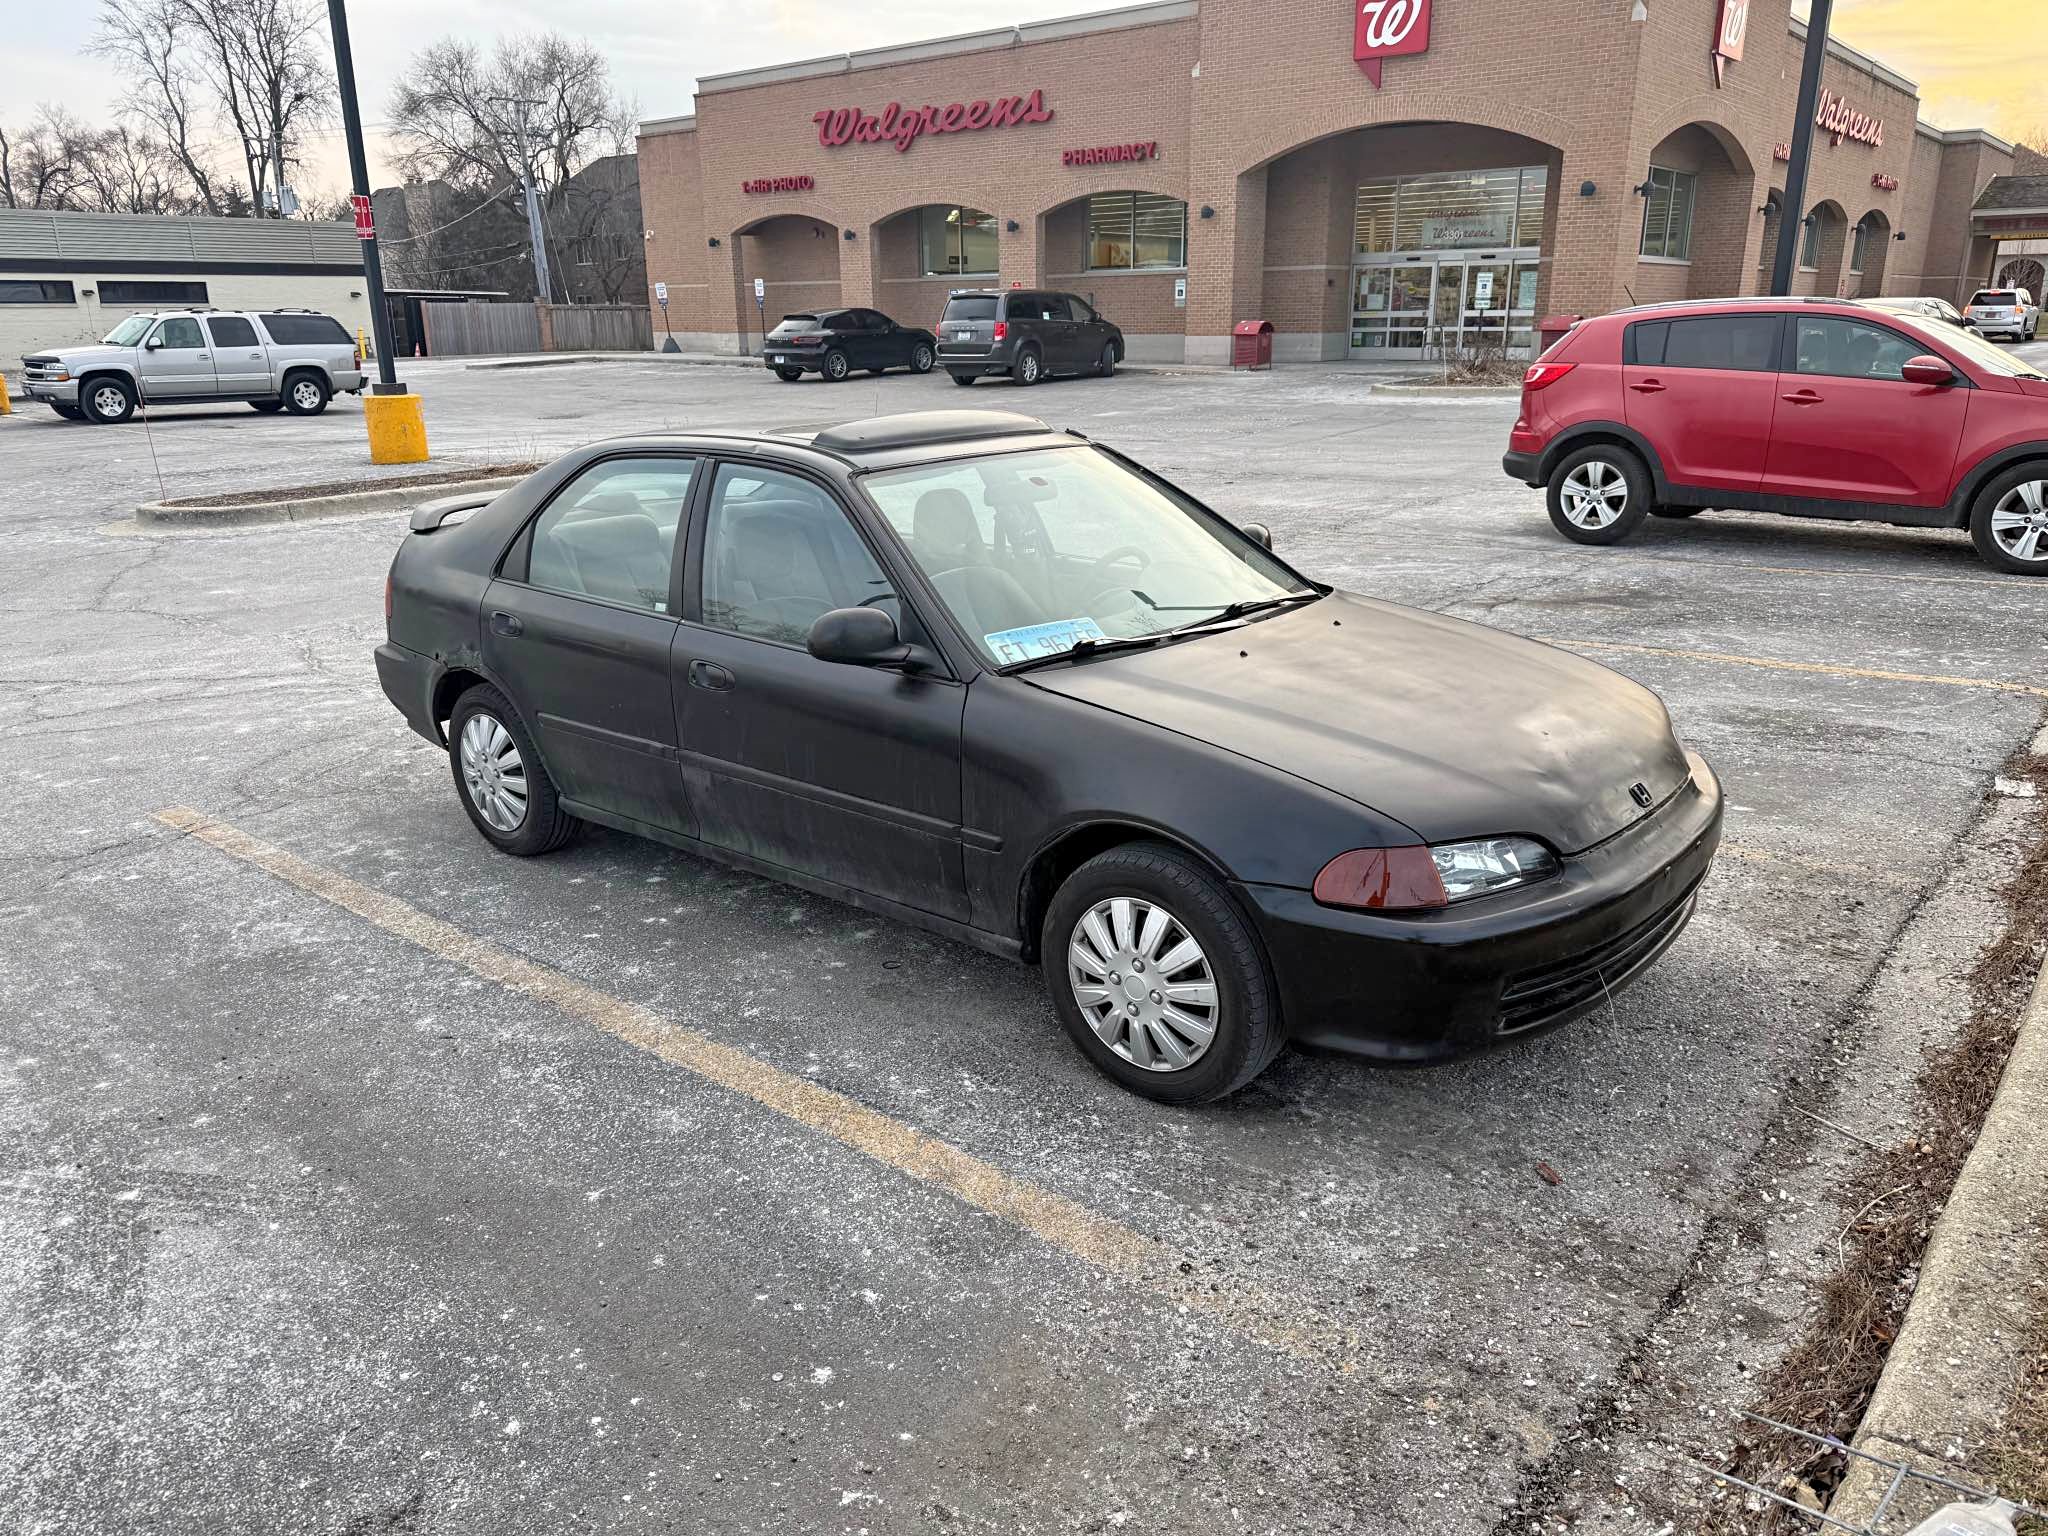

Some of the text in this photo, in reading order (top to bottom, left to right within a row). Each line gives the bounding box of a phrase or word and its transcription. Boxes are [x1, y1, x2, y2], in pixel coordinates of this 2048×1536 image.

[1363, 0, 1423, 48] W
[813, 89, 1054, 152] Walgreens
[1062, 142, 1156, 167] PHARMACY
[771, 175, 815, 193] PHOTO
